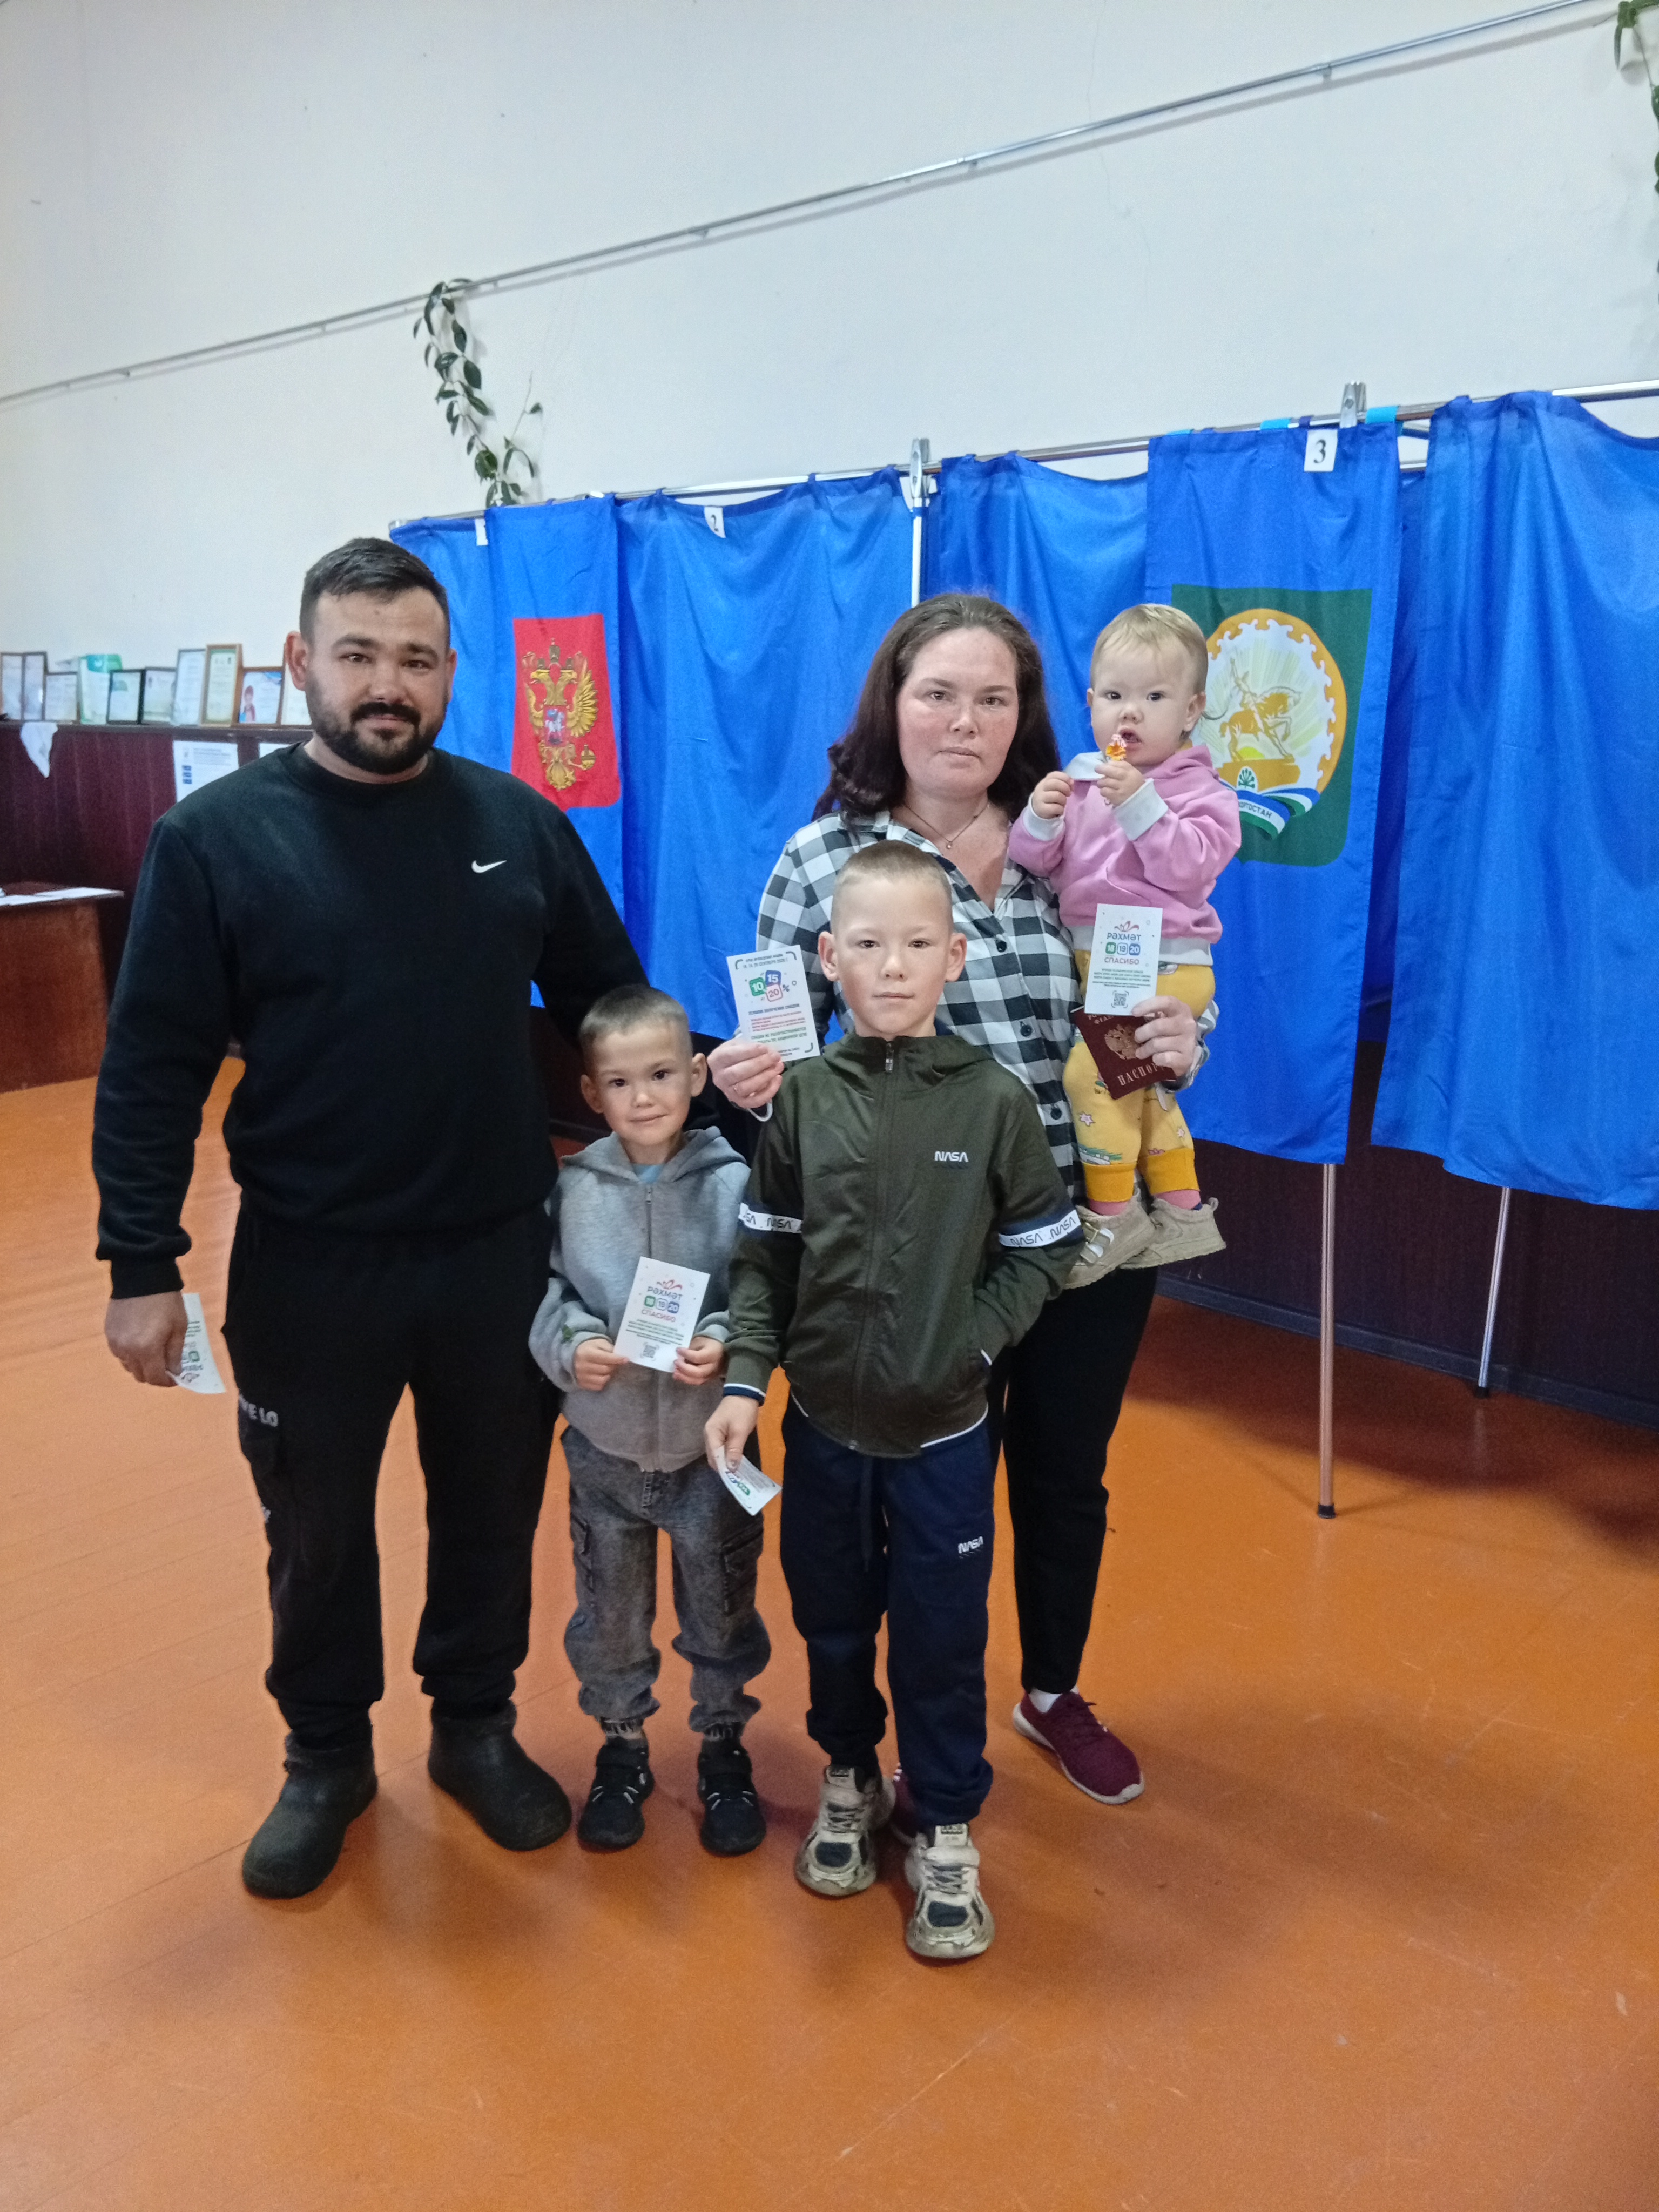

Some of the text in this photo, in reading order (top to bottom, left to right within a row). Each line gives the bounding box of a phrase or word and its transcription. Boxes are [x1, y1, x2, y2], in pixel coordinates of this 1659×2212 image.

[1313, 439, 1327, 463] 3
[1130, 946, 1138, 954] 20
[1104, 957, 1139, 965] СПАСИБО
[767, 974, 779, 983] 15
[752, 981, 764, 993] 10
[768, 988, 780, 998] 20
[1117, 1062, 1164, 1086] ПАСПОР
[934, 1151, 969, 1162] NASA
[1010, 1216, 1077, 1246] NASA NASA
